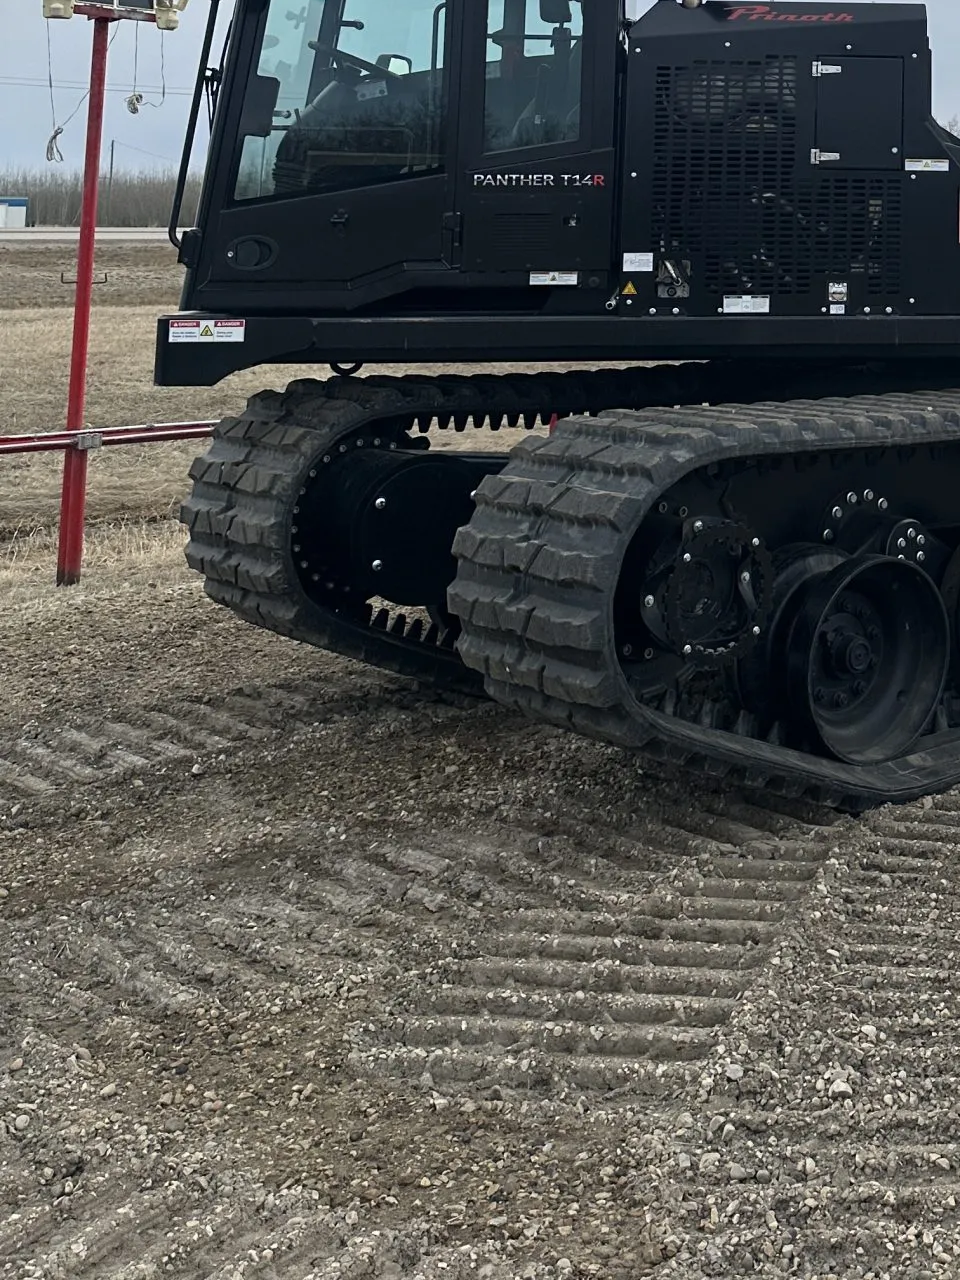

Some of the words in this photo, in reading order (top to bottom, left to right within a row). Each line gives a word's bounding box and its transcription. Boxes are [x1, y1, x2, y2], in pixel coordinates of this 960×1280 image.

[724, 5, 853, 21] Prinoth
[473, 174, 554, 186] PANTHER
[560, 174, 605, 186] T14R
